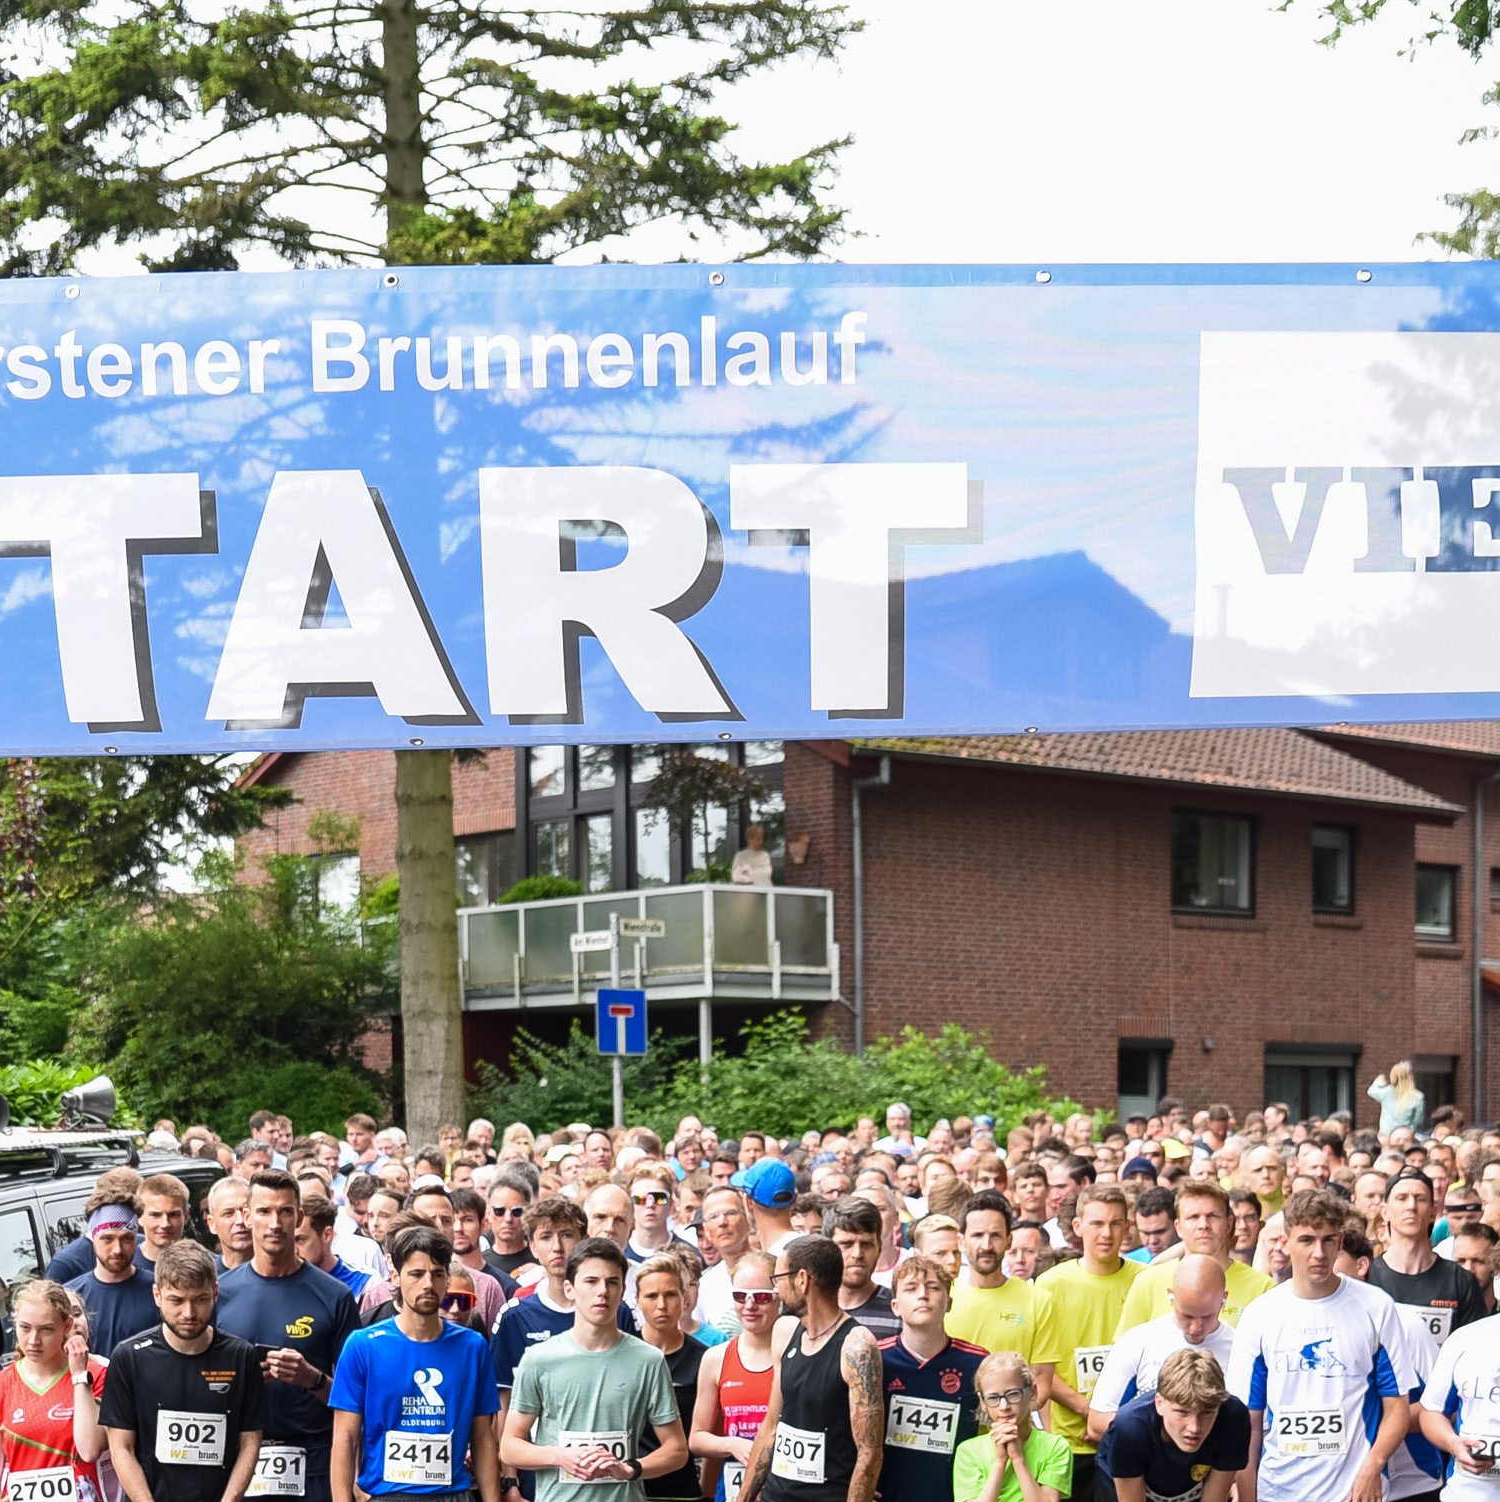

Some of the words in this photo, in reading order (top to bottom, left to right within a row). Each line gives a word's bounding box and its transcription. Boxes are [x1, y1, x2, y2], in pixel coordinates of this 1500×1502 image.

[309, 311, 869, 395] Brunnenlauf
[1430, 1299, 1458, 1308] emsys
[285, 1324, 305, 1335] VWG
[402, 1396, 428, 1406] REHA
[401, 1405, 446, 1416] ZENTRUM
[401, 1419, 446, 1427] OLDENBURG
[892, 1406, 954, 1433] 1441
[1278, 1414, 1343, 1435] 2525
[168, 1422, 216, 1444] 902
[892, 1432, 918, 1445] EWE
[776, 1434, 822, 1462] 2507
[1317, 1441, 1340, 1450] bruns
[198, 1450, 219, 1460] bruns
[388, 1442, 450, 1464] 2414
[255, 1456, 301, 1476] 791
[425, 1470, 446, 1479] bruns
[10, 1477, 73, 1502] 2700
[278, 1481, 299, 1490] bruns
